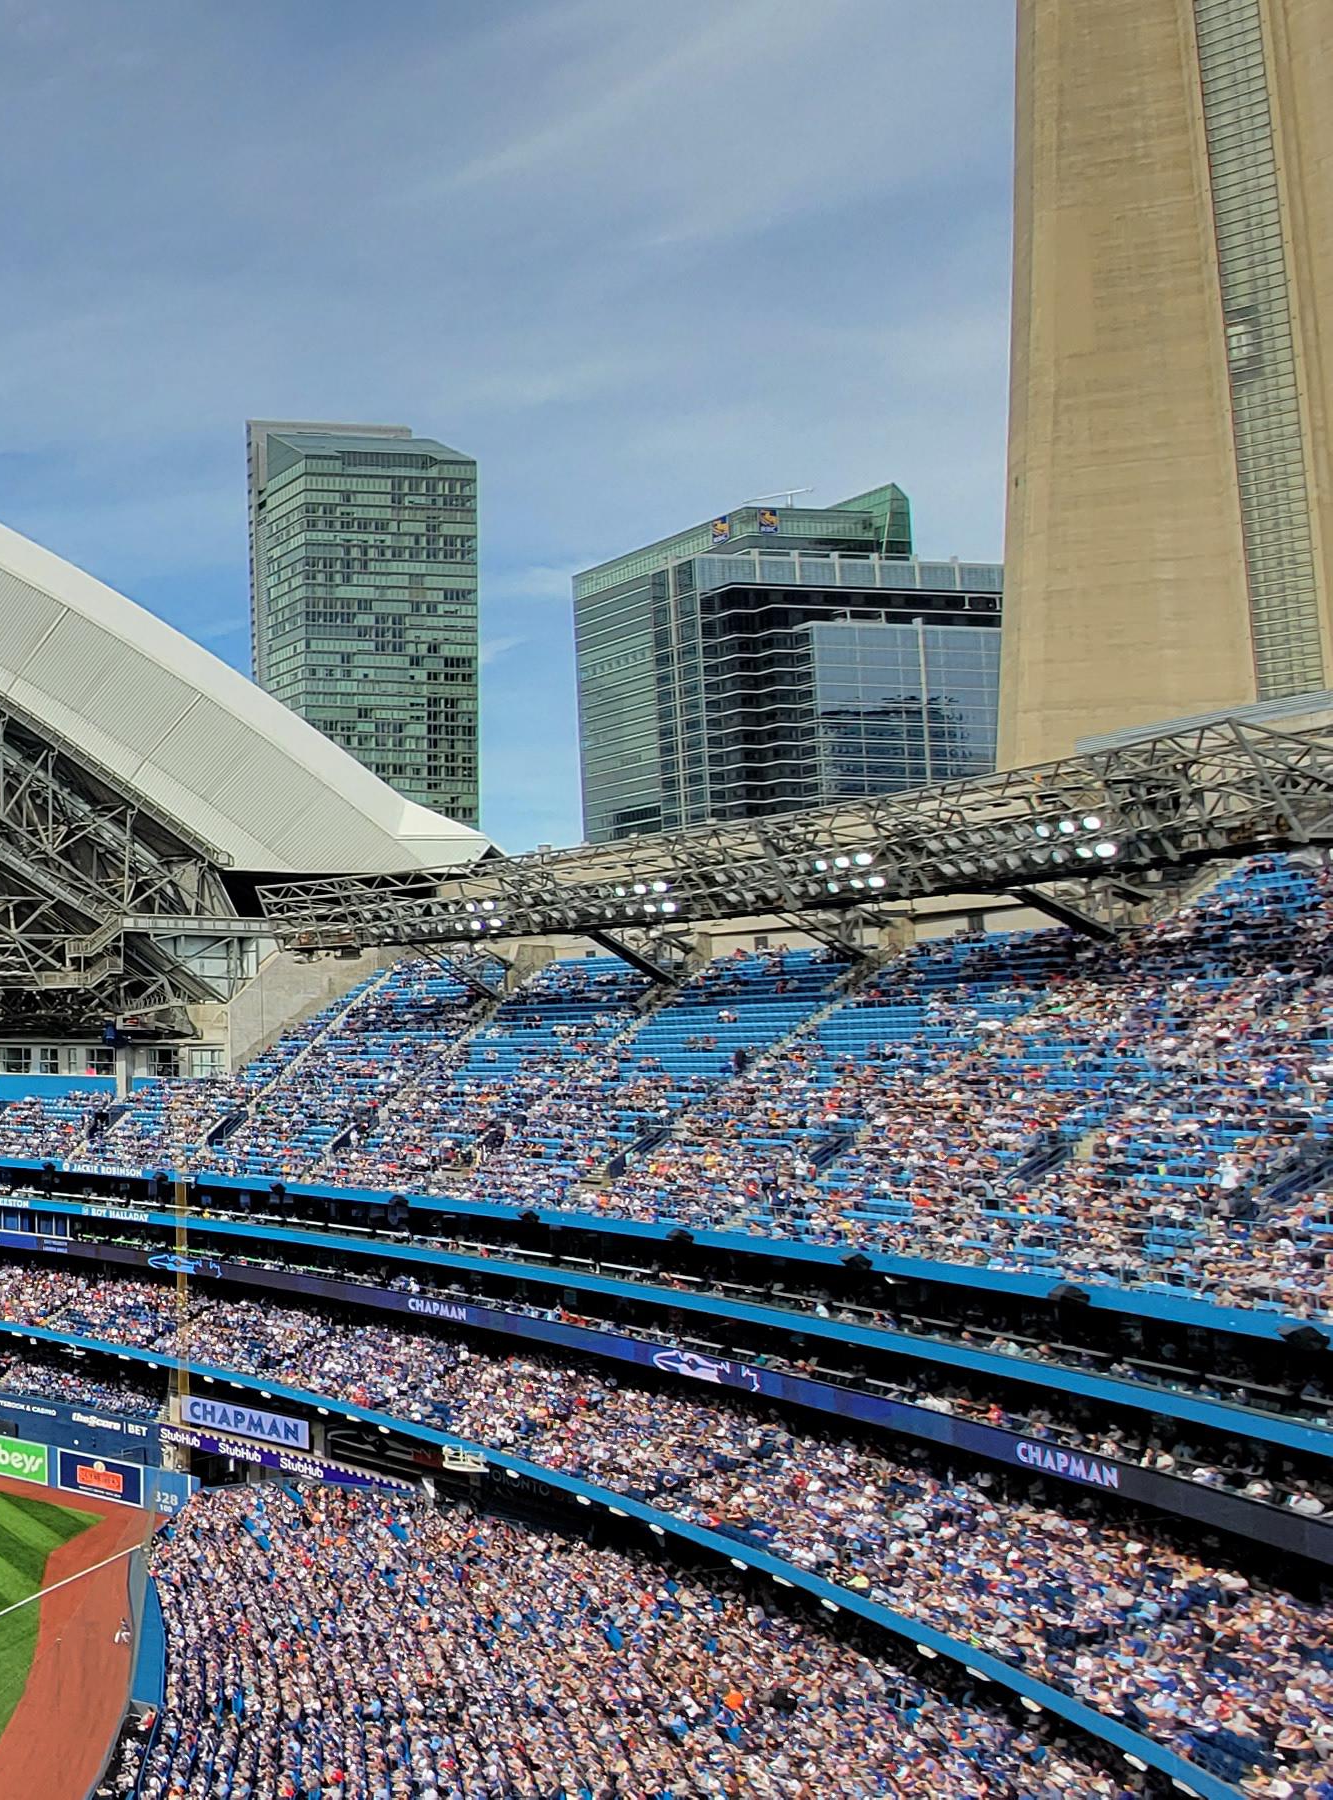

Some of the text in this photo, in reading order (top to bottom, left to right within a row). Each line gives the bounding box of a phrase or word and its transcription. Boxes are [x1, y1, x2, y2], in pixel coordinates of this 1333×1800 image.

[72, 1164, 143, 1177] JACKIE ROBINSON
[91, 1208, 149, 1222] ROY HALLADAY
[408, 1298, 468, 1321] CHAPMAN
[32, 1406, 57, 1417] CASINO
[71, 1412, 148, 1437] theScore BET
[189, 1401, 299, 1444] CHAPMAN
[159, 1428, 201, 1448] StubHub
[218, 1442, 262, 1463] StubHub
[279, 1457, 324, 1479] StubHub
[1016, 1442, 1118, 1489] CHAPMAN
[155, 1490, 179, 1506] 328
[160, 1504, 173, 1513] 100
